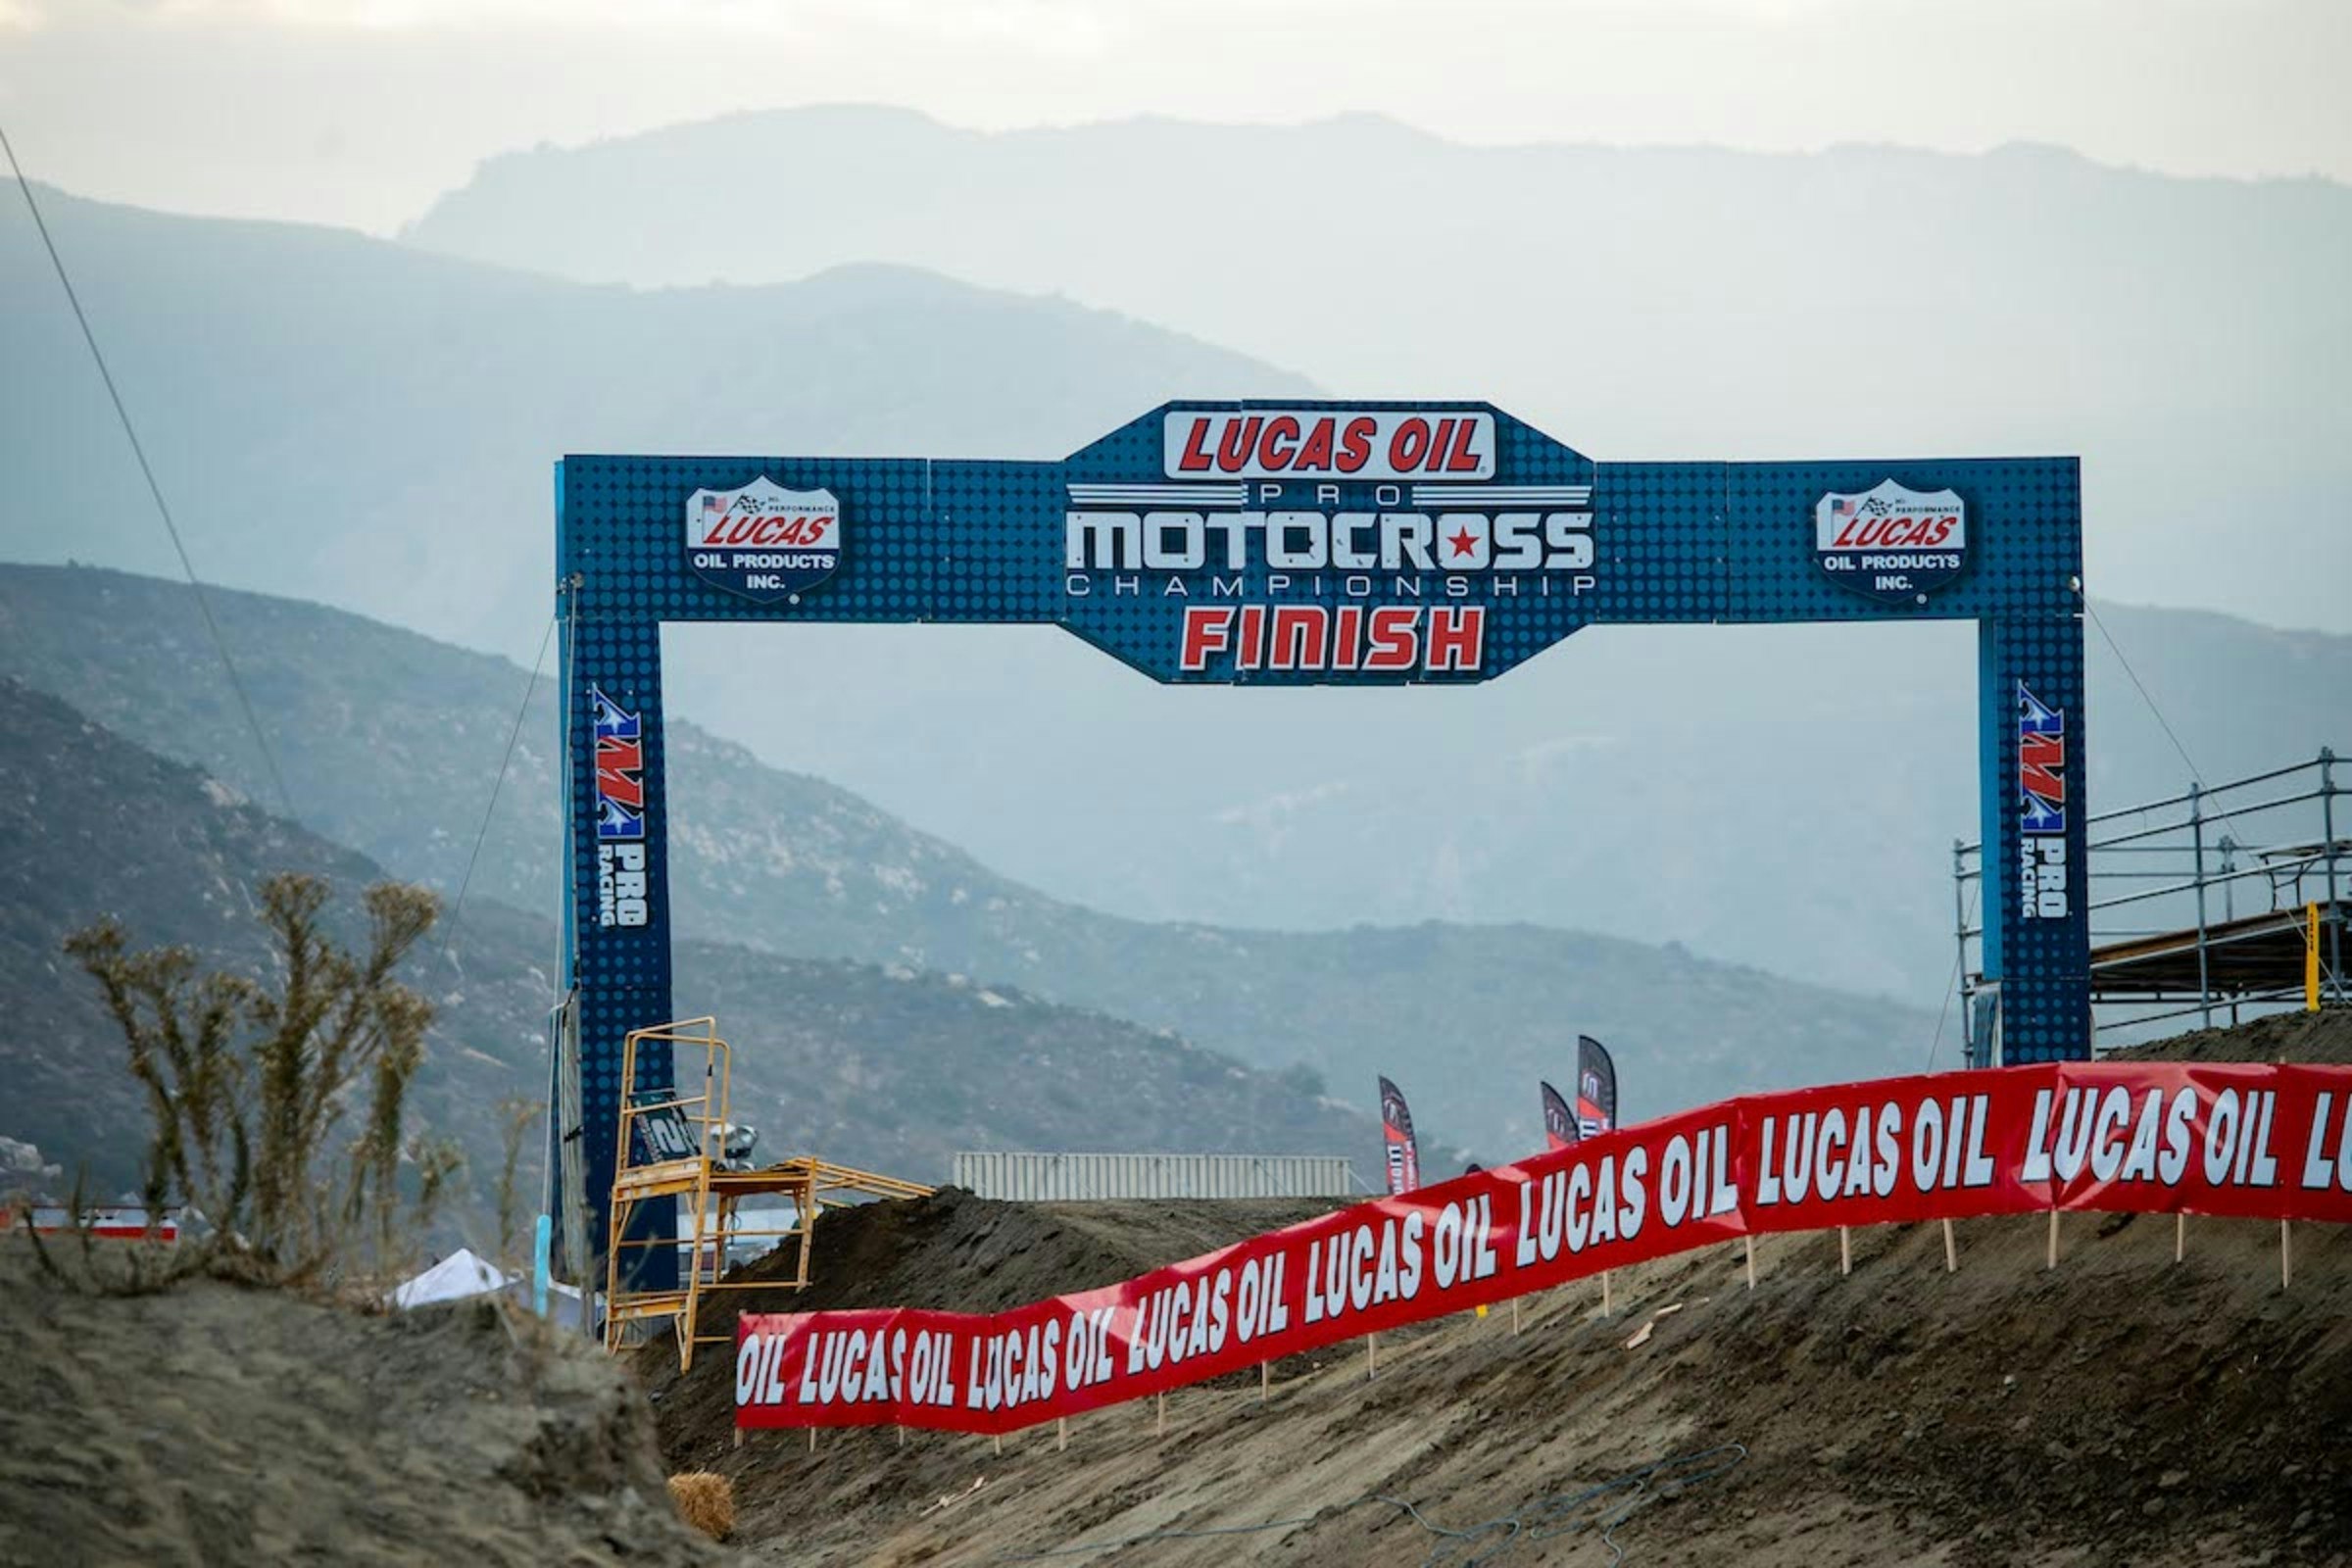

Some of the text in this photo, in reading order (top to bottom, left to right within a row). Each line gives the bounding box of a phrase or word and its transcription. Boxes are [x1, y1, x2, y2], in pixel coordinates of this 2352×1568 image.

[1178, 416, 1482, 471] LUCAS OIL
[1259, 485, 1401, 506] PRO
[702, 515, 835, 546] LUCAS
[1065, 512, 1595, 570] MOTOCROSS
[1833, 516, 1958, 547] LUCAS
[693, 554, 835, 568] OIL PRODUCTS
[747, 575, 785, 589] INC.
[1824, 555, 1960, 570] OIL PRODUCTS
[1065, 574, 1596, 597] CHAMPIONSHIP
[1875, 576, 1913, 590] INC.
[1179, 605, 1486, 671] FINISH
[598, 844, 616, 927] RACING
[614, 844, 648, 927] PRO
[2021, 838, 2036, 918] RACING
[2036, 838, 2068, 918] PRO
[735, 1333, 787, 1405] OIL
[798, 1328, 906, 1405] LUCAS
[909, 1329, 955, 1405] OIL
[966, 1318, 1061, 1412] LUCAS
[1065, 1306, 1116, 1391] OIL
[1127, 1268, 1231, 1374] LUCAS
[1237, 1250, 1289, 1344] OIL
[1304, 1210, 1424, 1324] LUCAS
[1434, 1193, 1496, 1290] OIL
[1515, 1145, 1648, 1268] LUCAS
[1659, 1124, 1739, 1228] OIL
[1757, 1101, 1901, 1205] LUCAS
[1912, 1094, 1995, 1193] OIL
[2021, 1085, 2198, 1187] LUCAS
[2203, 1087, 2278, 1188] OIL
